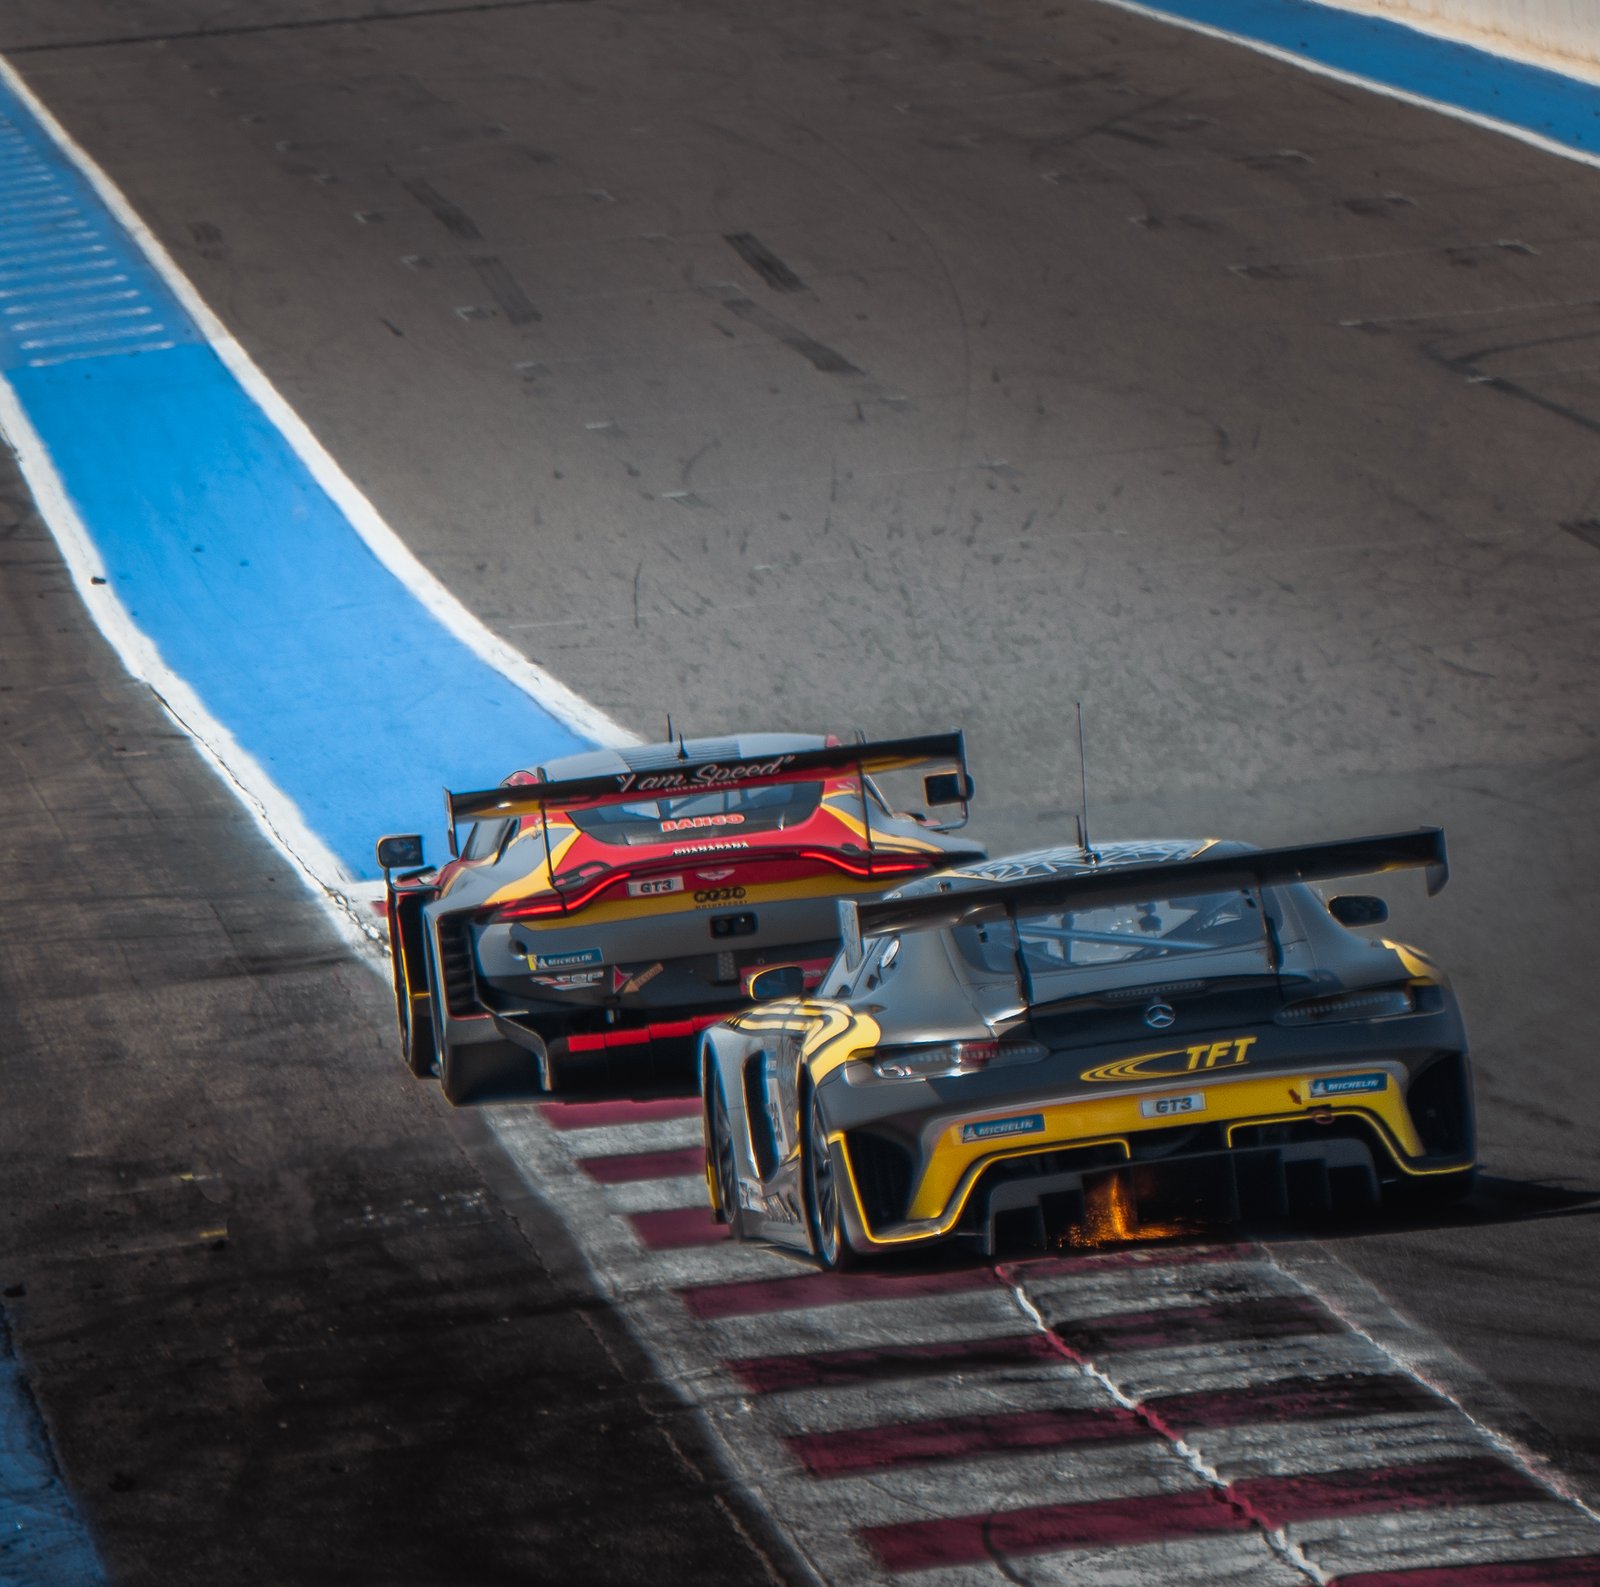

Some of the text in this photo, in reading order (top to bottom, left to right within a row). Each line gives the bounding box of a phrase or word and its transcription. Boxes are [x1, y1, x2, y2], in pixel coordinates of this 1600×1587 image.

[638, 773, 687, 790] am
[640, 879, 673, 893] GT3
[549, 953, 593, 966] MICHELIN
[1187, 1037, 1257, 1071] TFT
[1328, 1080, 1379, 1091] MICHELIN
[1155, 1097, 1193, 1113] GT3
[979, 1120, 1034, 1136] MICHELIN
